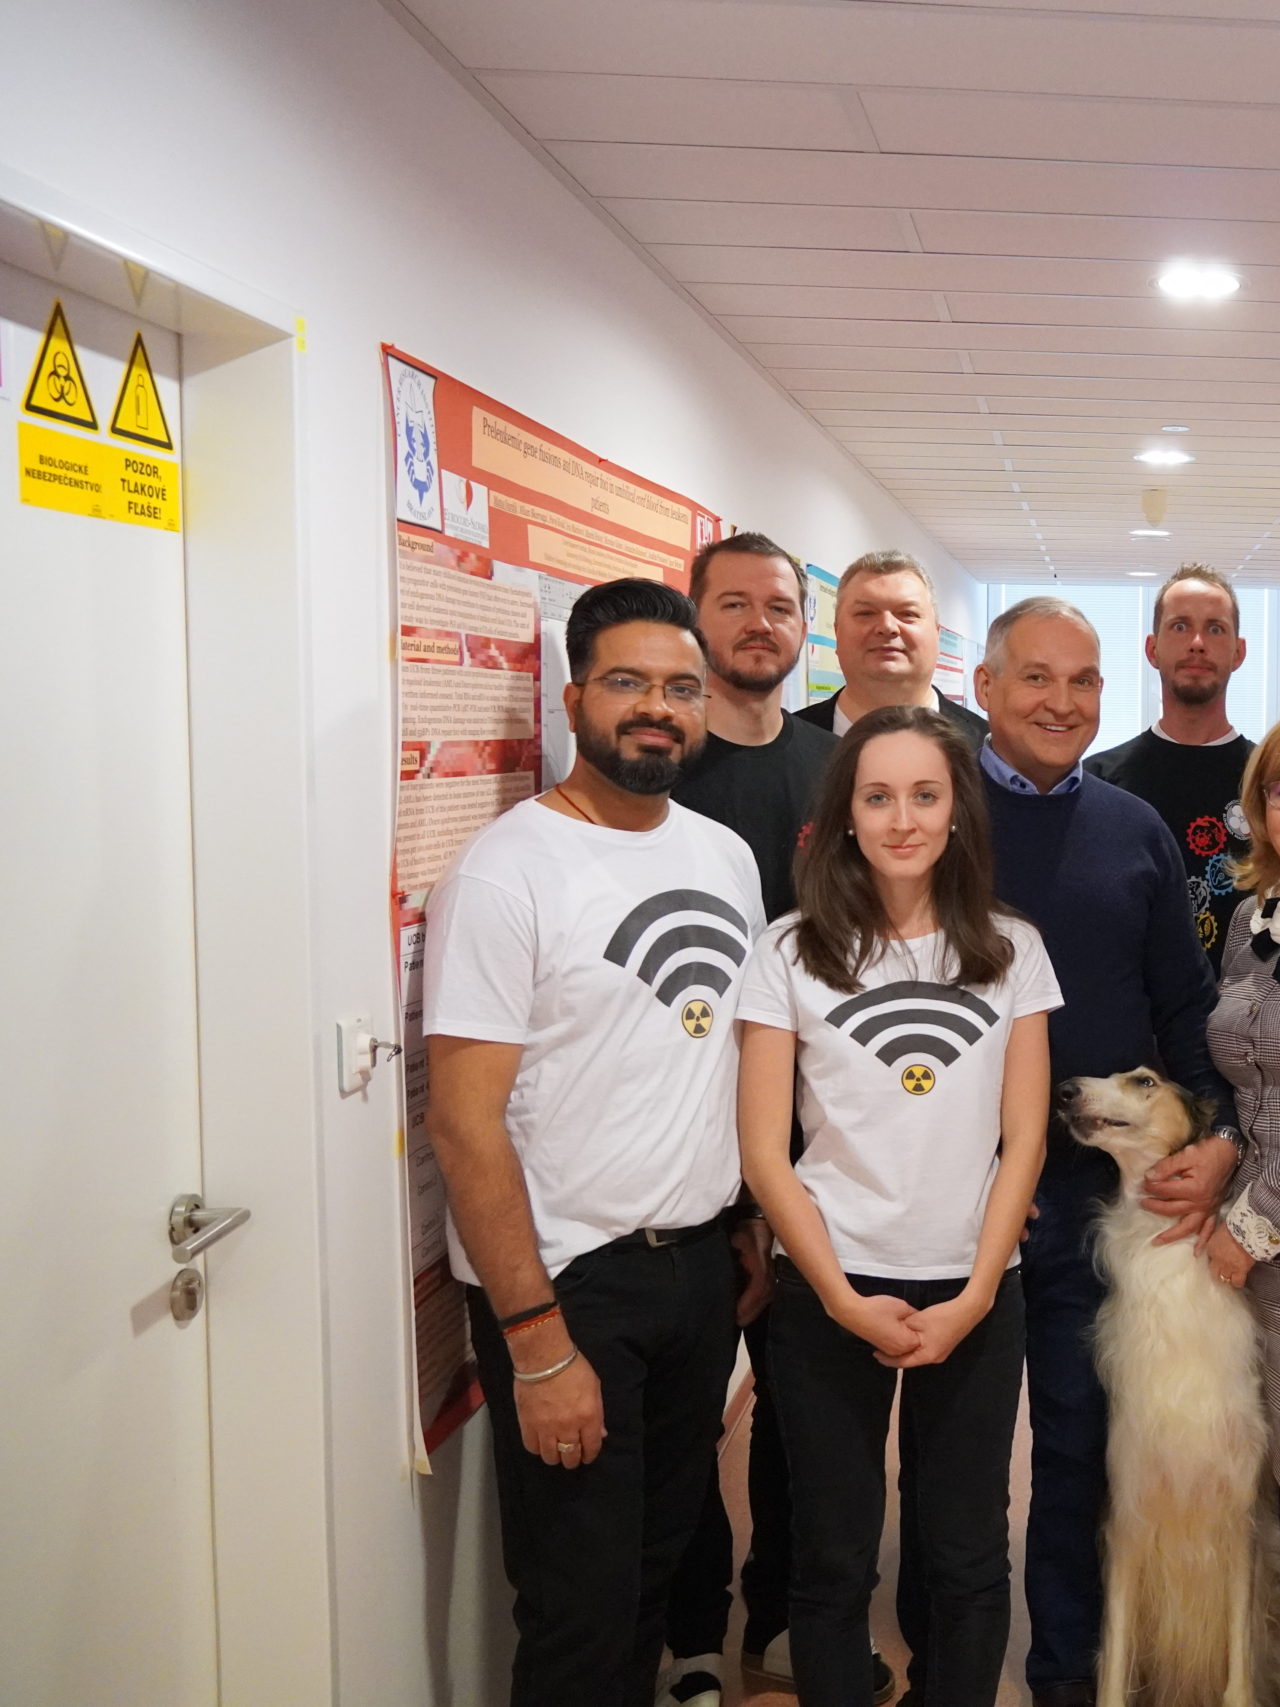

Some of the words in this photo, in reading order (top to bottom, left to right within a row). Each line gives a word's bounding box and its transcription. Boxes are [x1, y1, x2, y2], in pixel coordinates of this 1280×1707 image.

[483, 417, 522, 452] Preleukemic
[523, 442, 538, 458] gene
[539, 444, 561, 468] fusions
[39, 454, 88, 475] BIOLOGICKÉ
[125, 458, 162, 482] POZOR,
[120, 478, 167, 501] TLAKOVÉ
[423, 640, 434, 653] and
[436, 643, 459, 655] methods
